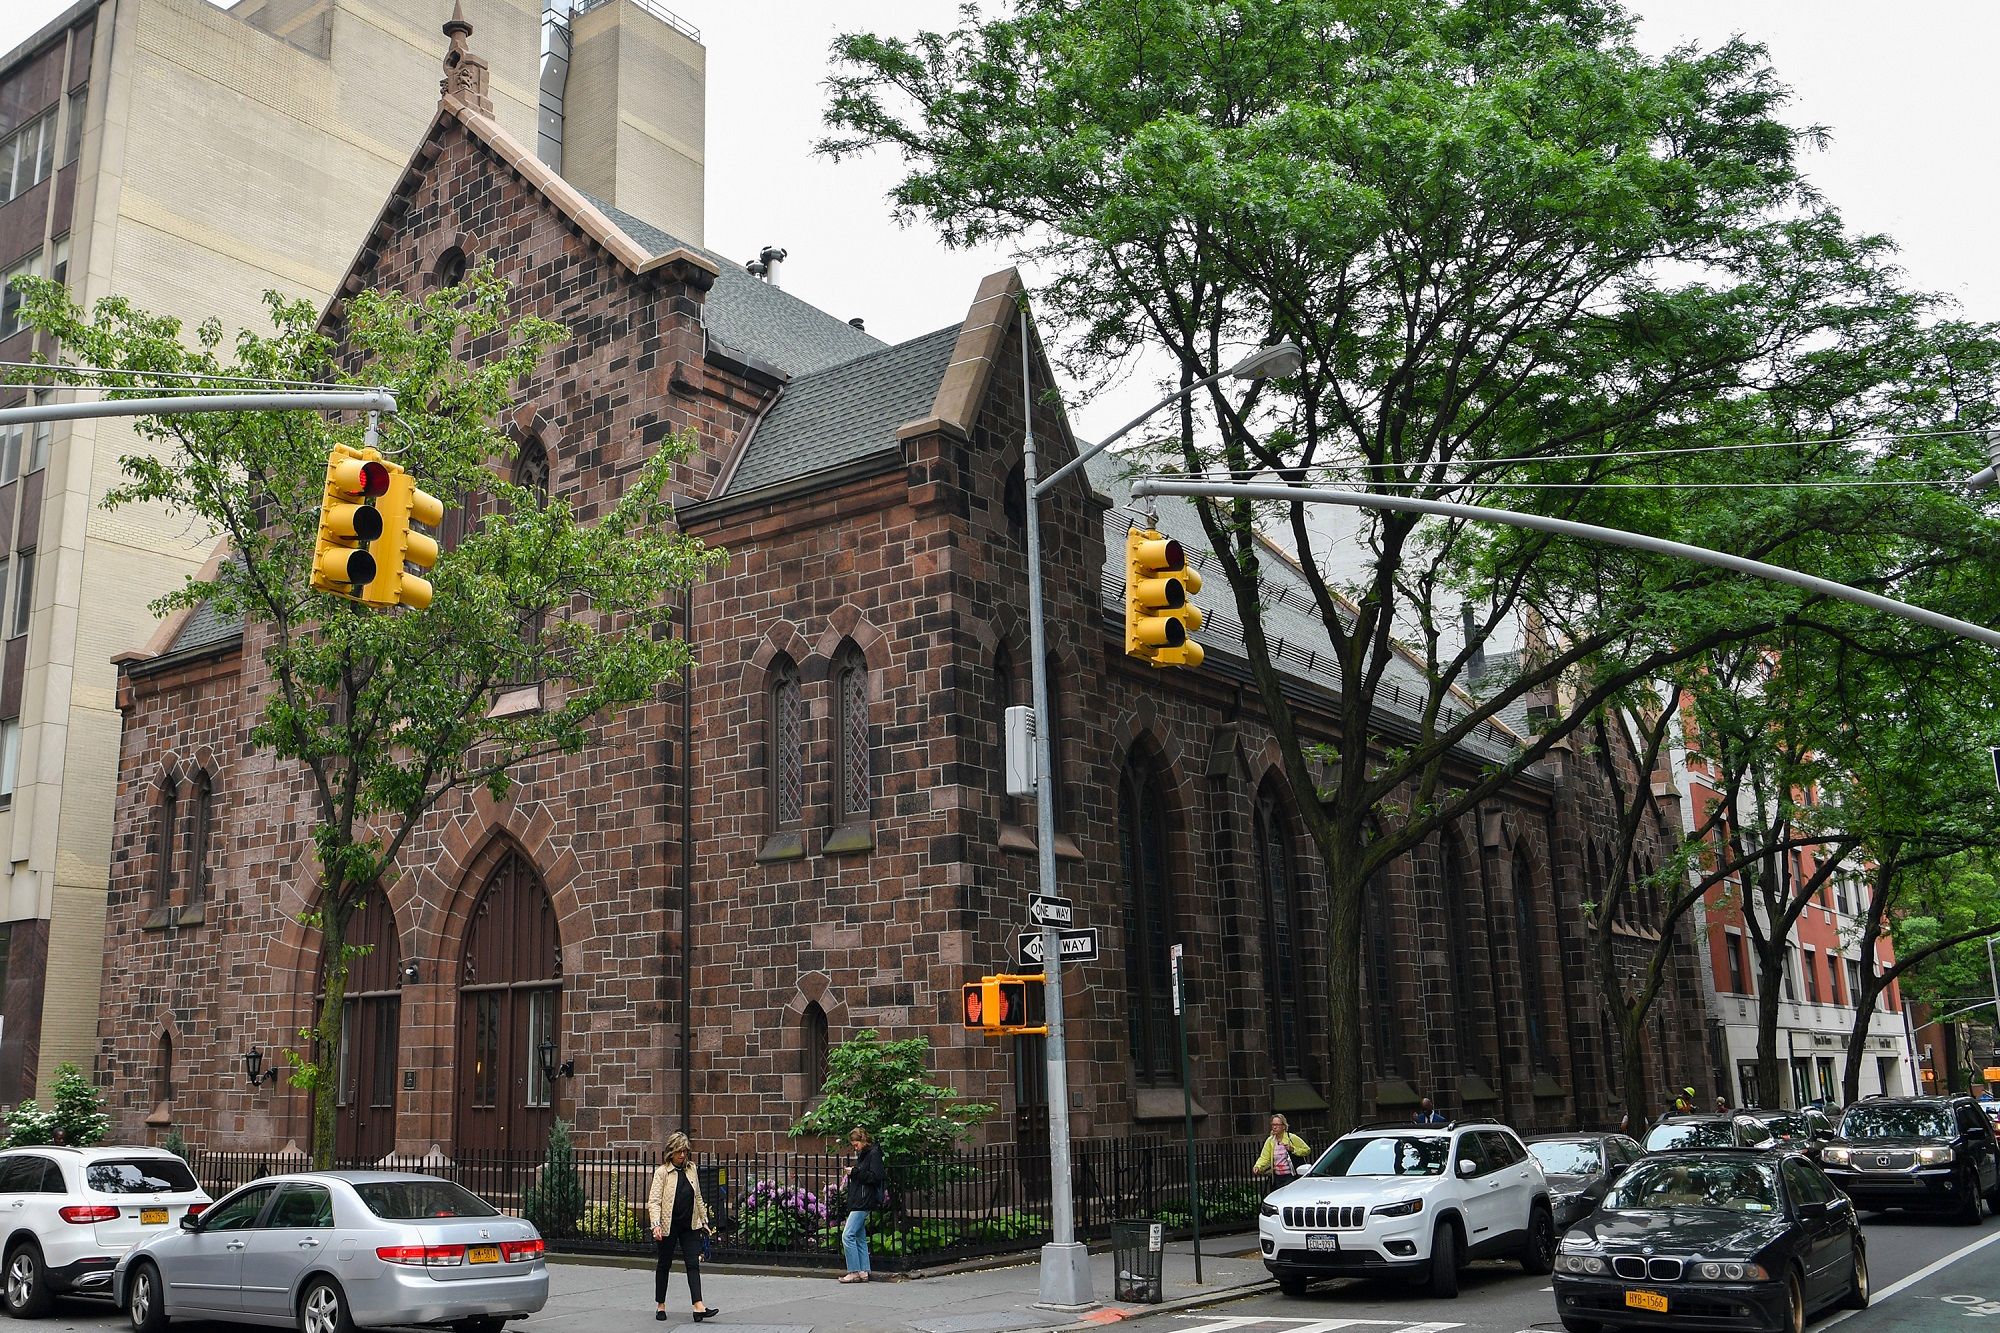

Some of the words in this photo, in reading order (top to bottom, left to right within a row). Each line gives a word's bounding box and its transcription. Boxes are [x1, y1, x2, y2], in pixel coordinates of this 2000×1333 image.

[1035, 904, 1049, 917] ONE
[1055, 906, 1069, 919] WAY
[1031, 942, 1044, 954] ON
[1062, 939, 1086, 952] WAY
